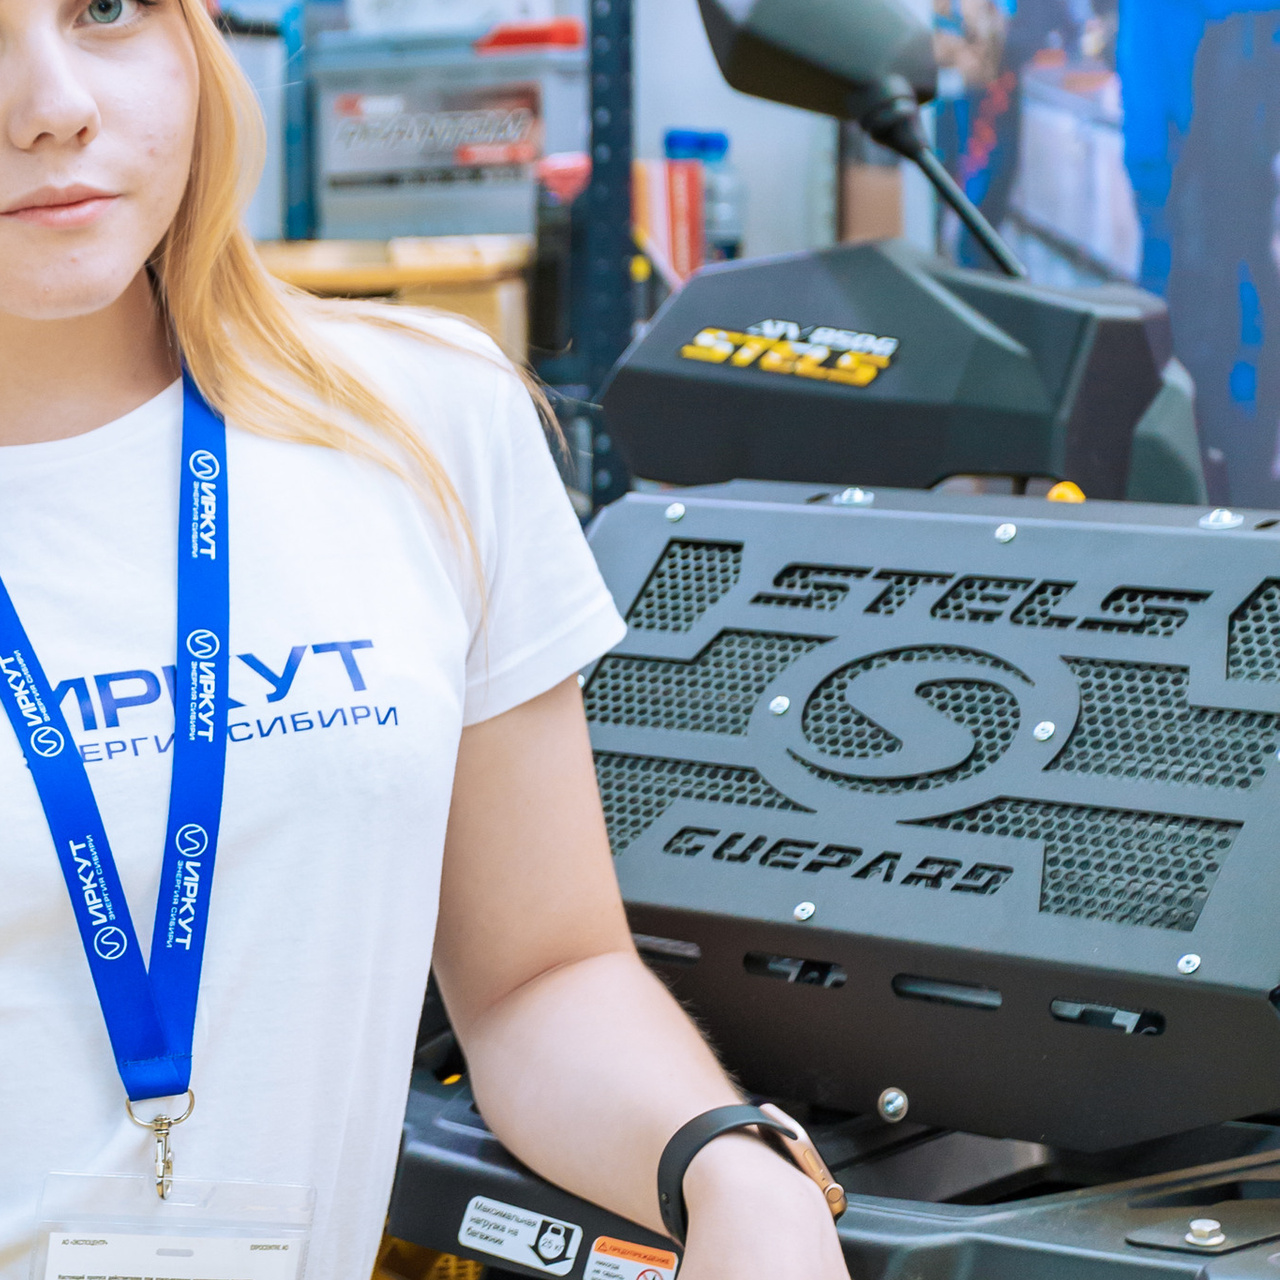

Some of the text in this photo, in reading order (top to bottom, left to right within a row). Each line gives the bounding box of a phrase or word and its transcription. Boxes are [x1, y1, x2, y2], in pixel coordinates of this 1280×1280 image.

[681, 327, 890, 387] STELS
[199, 482, 217, 560] ИРКУТ
[749, 562, 1214, 637] STELS
[52, 639, 374, 731] ИРУТ
[197, 661, 216, 743] ИРКУТ
[228, 705, 398, 742] СИБИРИ
[69, 840, 108, 926] ИРКУТ
[86, 834, 116, 921] ЭНЕРГИЯ СИБИРИ
[662, 825, 1014, 896] GUEPARD
[166, 860, 184, 948] ЭНЕРГИЯ СИБИРИ
[175, 860, 201, 950] ИРКУТ
[541, 1238, 553, 1249] 25
